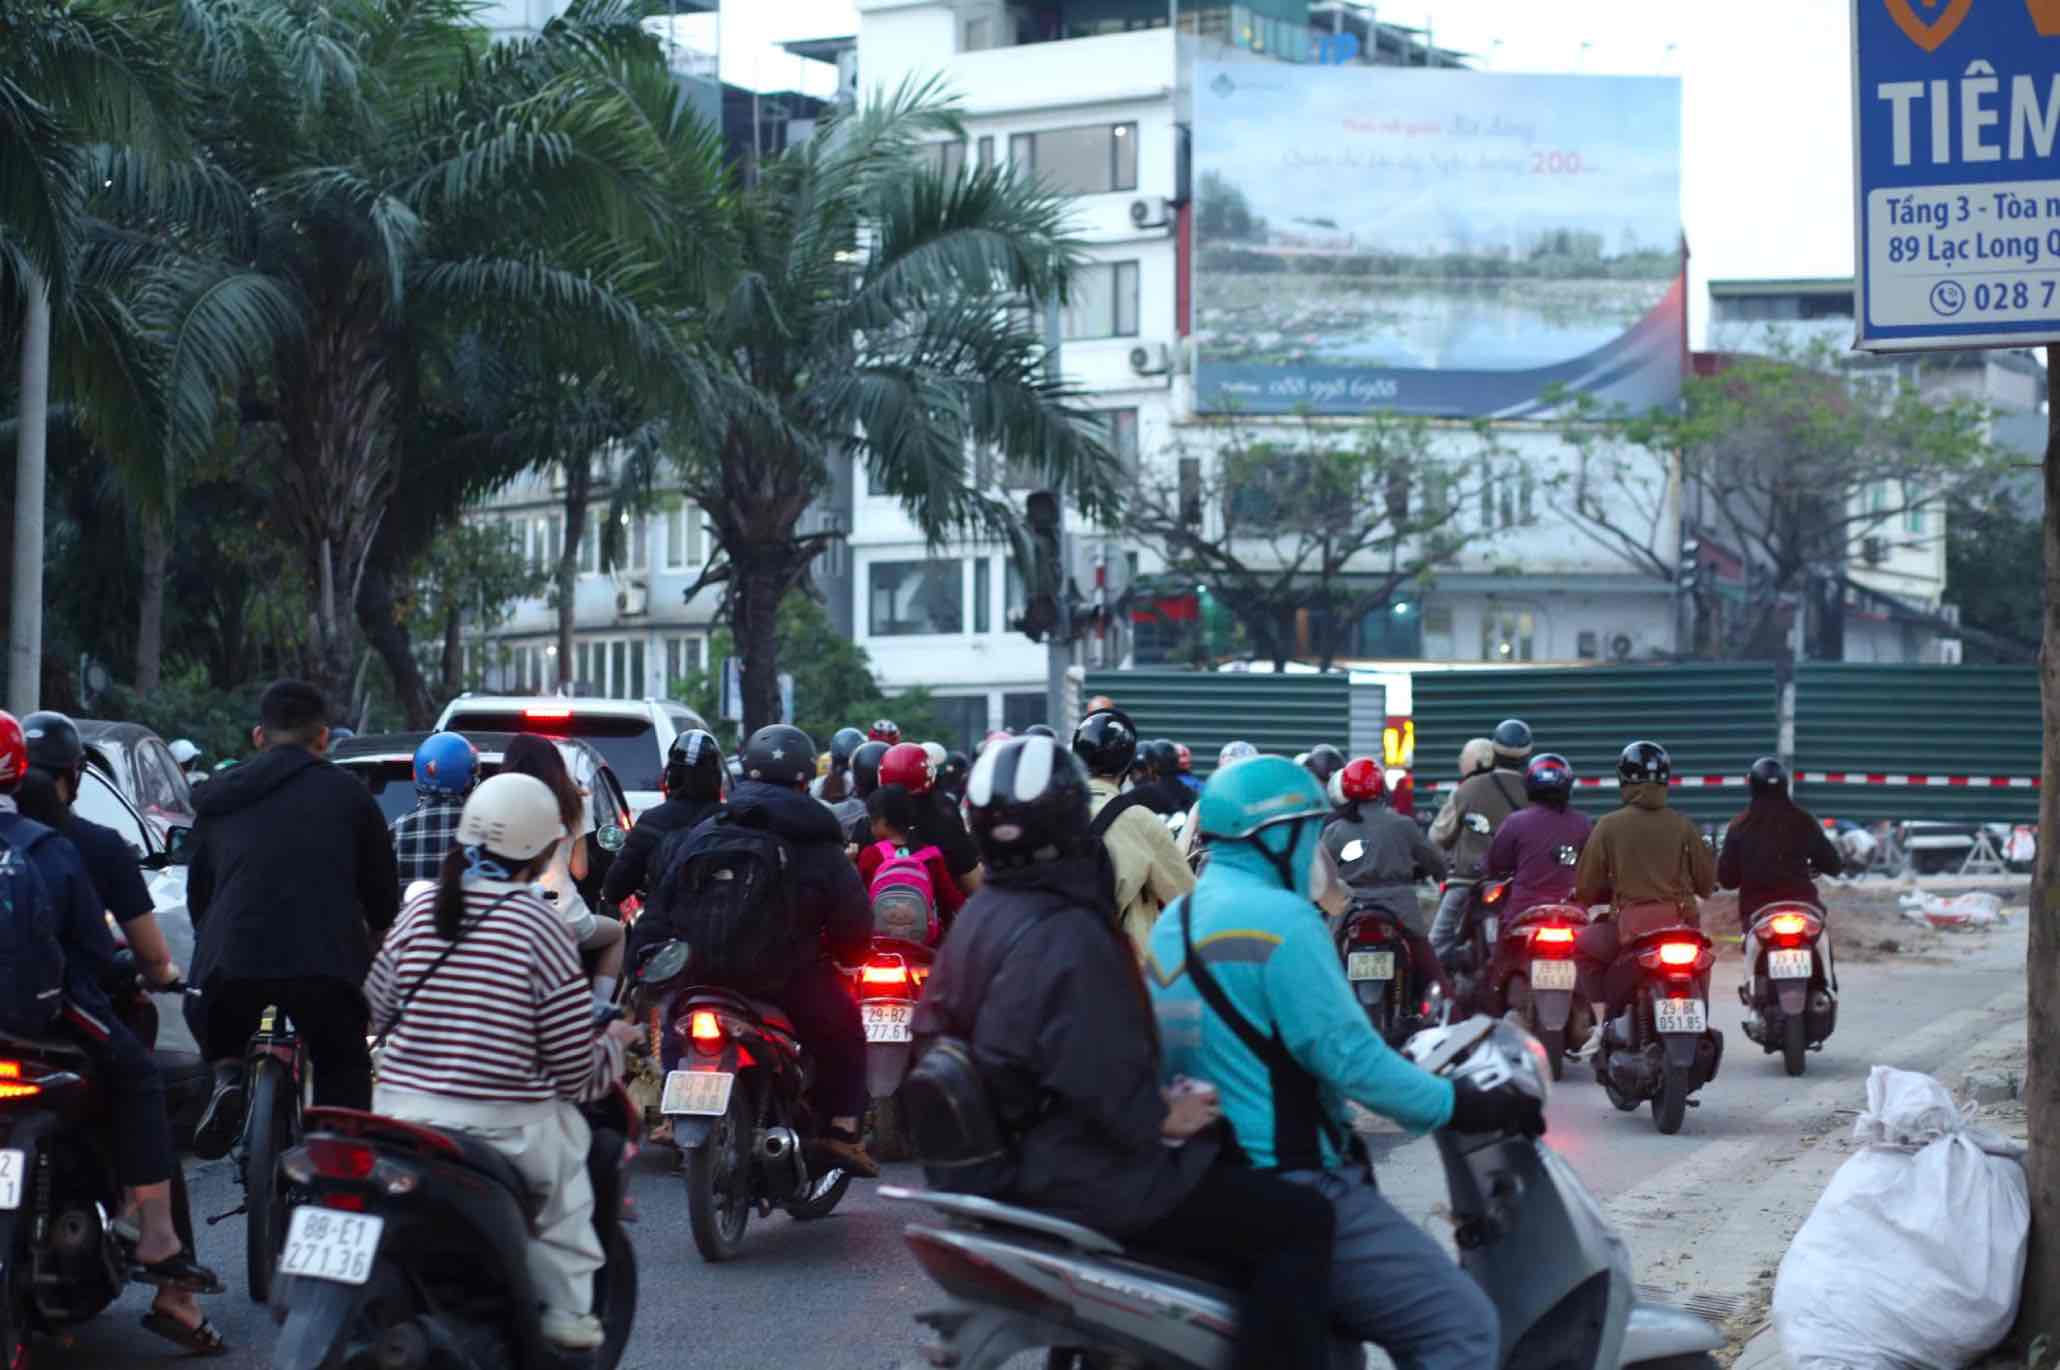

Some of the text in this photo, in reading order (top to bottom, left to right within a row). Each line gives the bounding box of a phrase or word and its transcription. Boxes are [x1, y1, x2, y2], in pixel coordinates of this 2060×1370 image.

[1877, 59, 2060, 166] TIÊM
[1530, 150, 1583, 175] 200
[1956, 195, 1970, 222] 3
[1993, 191, 2037, 220] Tòa
[1889, 235, 1921, 263] 89
[1928, 233, 1969, 268] Lạc
[1976, 231, 2039, 264] Long
[1974, 280, 2056, 311] 028 7
